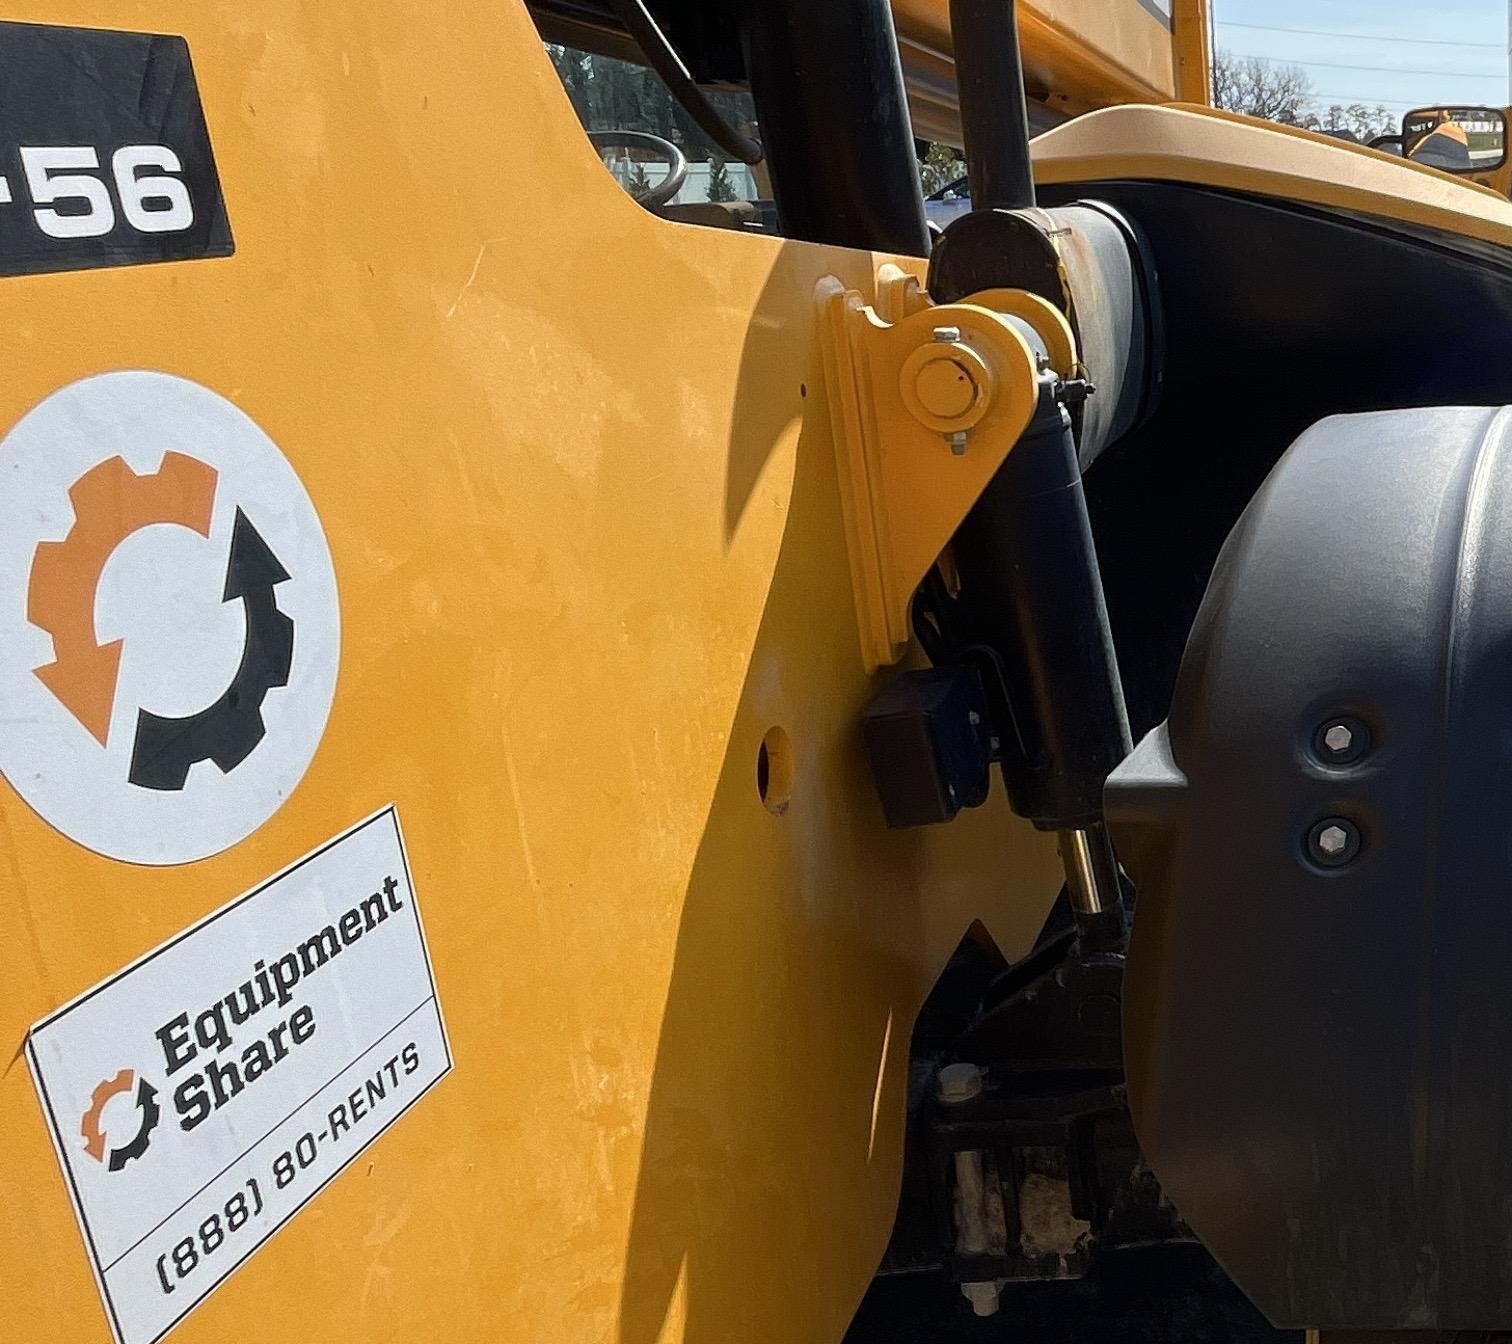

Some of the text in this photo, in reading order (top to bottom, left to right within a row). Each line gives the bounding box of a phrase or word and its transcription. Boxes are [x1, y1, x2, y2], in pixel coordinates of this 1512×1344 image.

[155, 875, 404, 1077] Equipment
[173, 1005, 317, 1133] Share
[156, 1042, 421, 1294] (888) 80-RENTS
